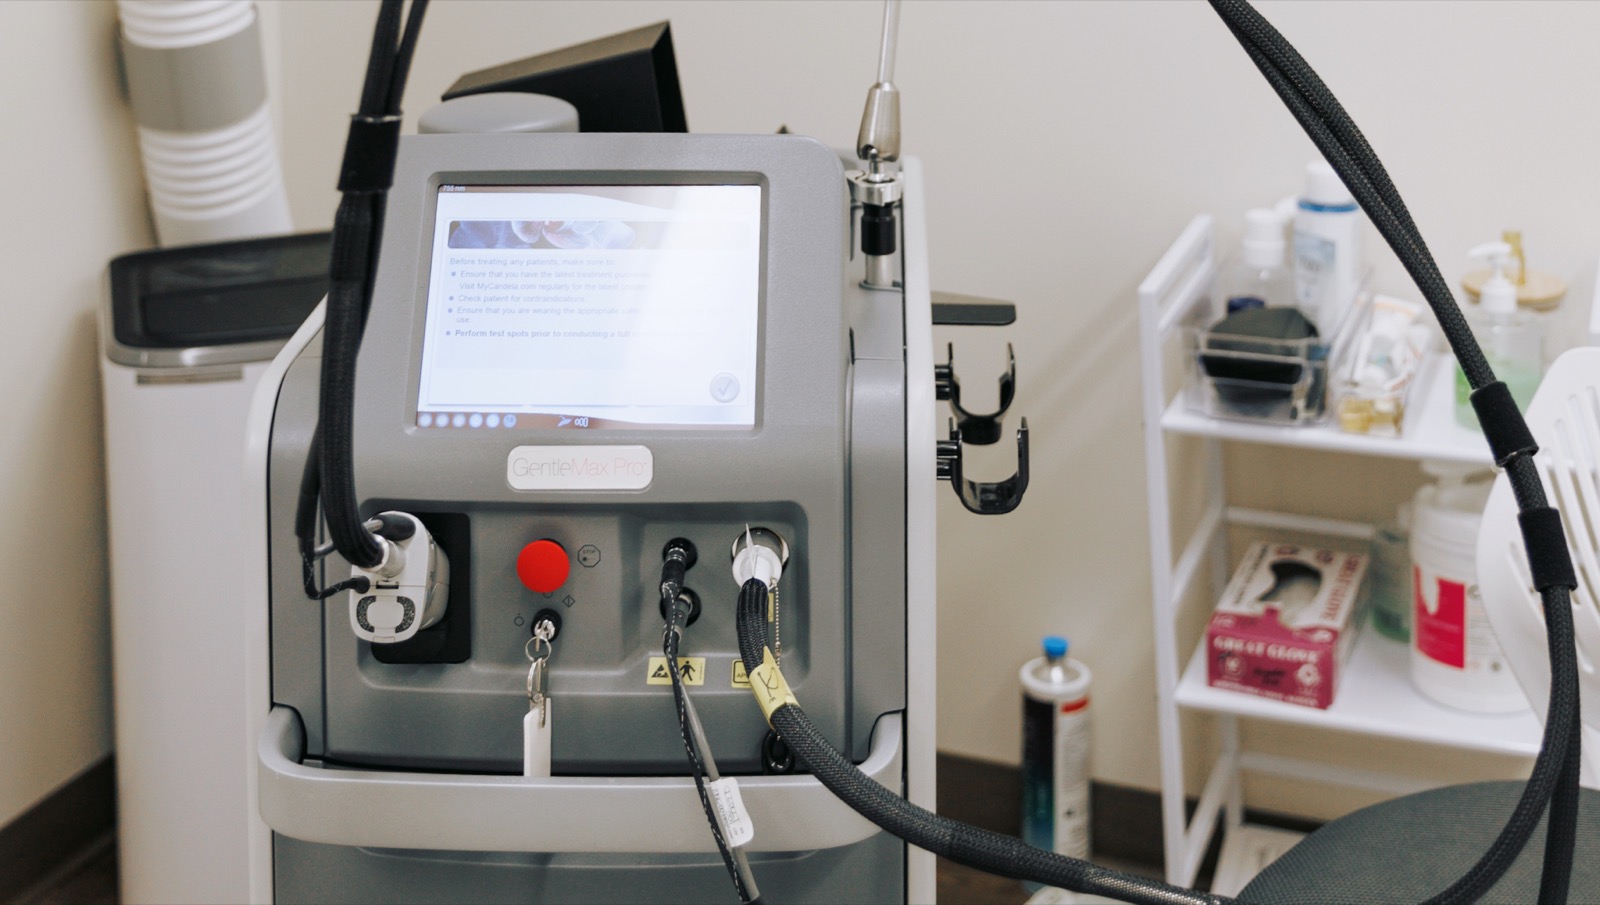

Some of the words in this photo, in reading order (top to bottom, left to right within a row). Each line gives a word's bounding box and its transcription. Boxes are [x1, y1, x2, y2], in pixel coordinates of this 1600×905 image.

[449, 257, 475, 265] Before
[478, 258, 507, 267] treating
[509, 259, 524, 267] any
[562, 258, 584, 266] make
[460, 270, 486, 278] Ensure
[488, 270, 503, 278] that
[505, 271, 519, 279] you
[520, 270, 538, 278] have
[540, 270, 552, 278] the
[576, 271, 613, 279] treatment
[459, 282, 475, 290] Visit
[538, 283, 570, 291] regularly
[458, 294, 481, 302] Check
[483, 295, 509, 303] patient
[456, 306, 483, 314] Ensure
[485, 306, 500, 314] that
[502, 307, 516, 315] you
[532, 307, 561, 316] wearing
[577, 307, 618, 316] appropriate
[455, 329, 487, 337] Perform
[507, 330, 529, 338] spots
[531, 330, 551, 338] prior
[563, 330, 608, 339] conducting
[512, 457, 608, 477] GentleMax
